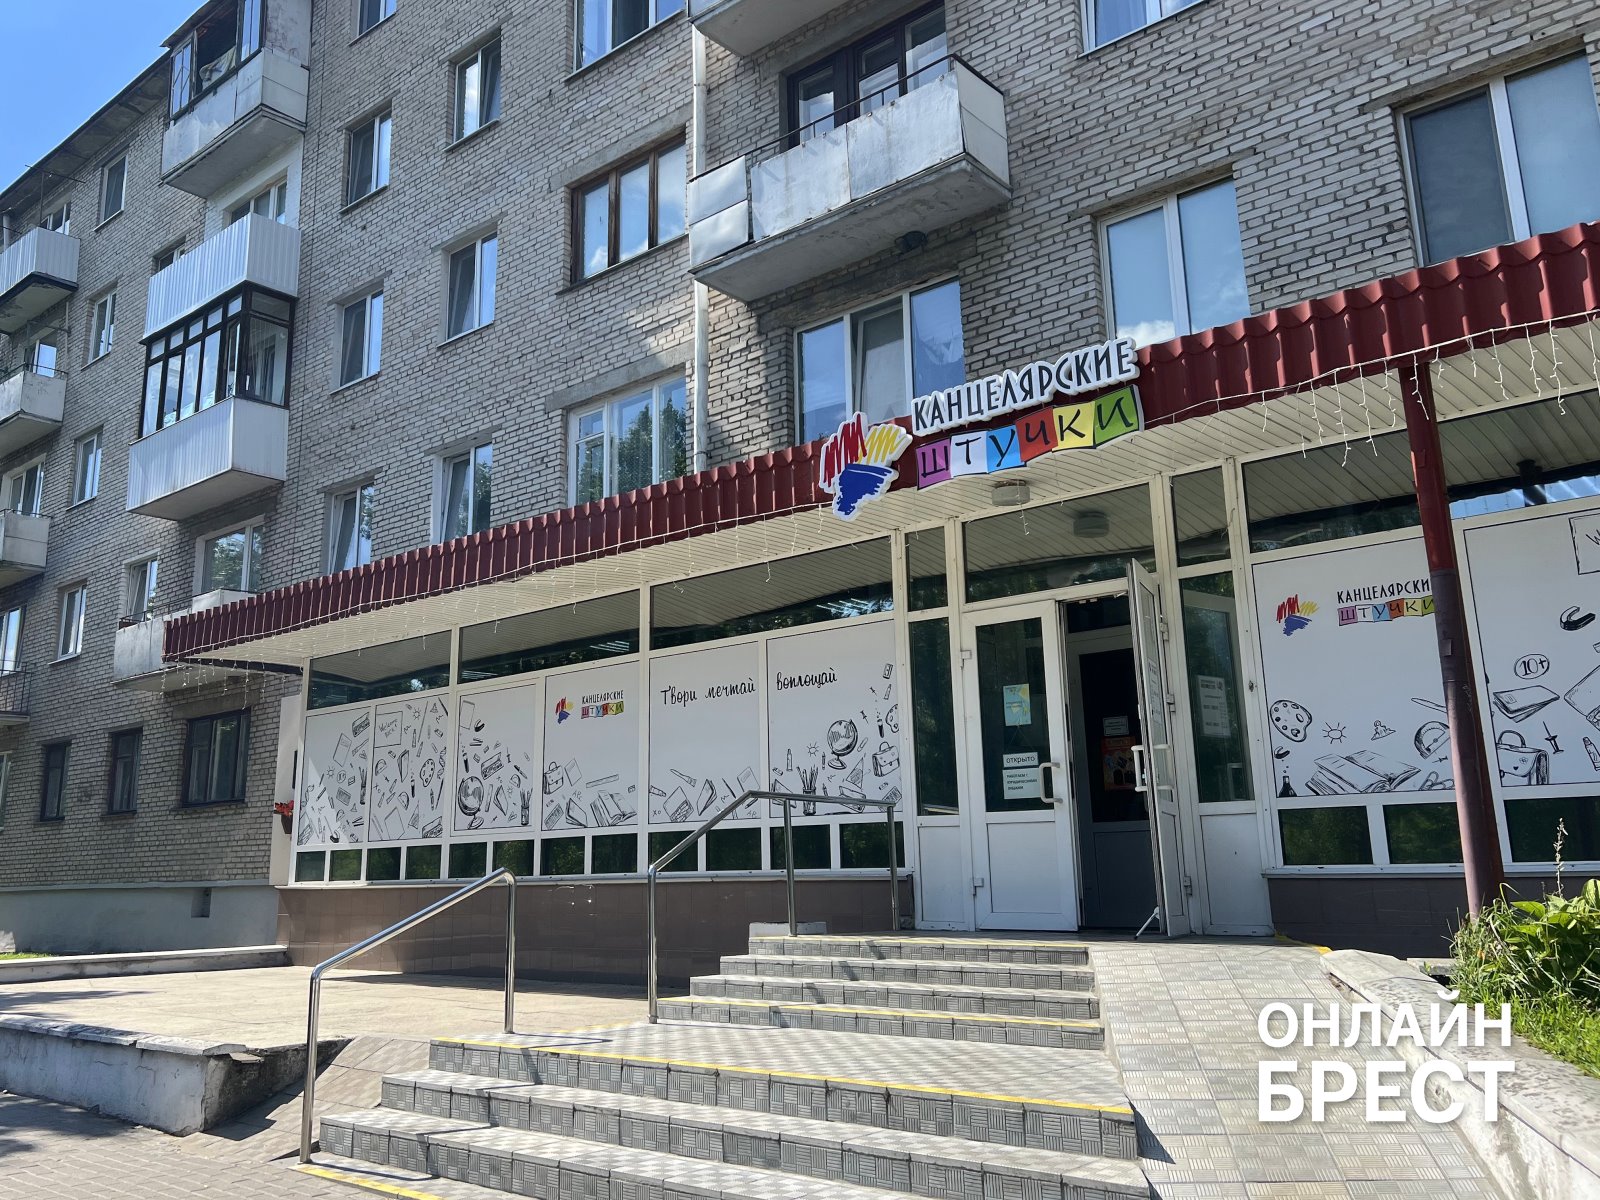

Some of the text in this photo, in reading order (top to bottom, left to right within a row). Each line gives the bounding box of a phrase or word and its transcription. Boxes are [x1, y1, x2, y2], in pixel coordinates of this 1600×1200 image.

[912, 337, 1140, 436] КАНЦЕЛЯРСКИЕ
[918, 390, 1139, 485] ШТУЧКИ
[1337, 578, 1430, 604] КАНЦЕЛЯРСКИ
[1519, 658, 1547, 676] 10+
[581, 689, 624, 705] КАНЦЕЛЯРСКИЕ
[660, 667, 838, 707] Твори мечтай воплощай
[581, 701, 624, 717] ШТУЧКИ
